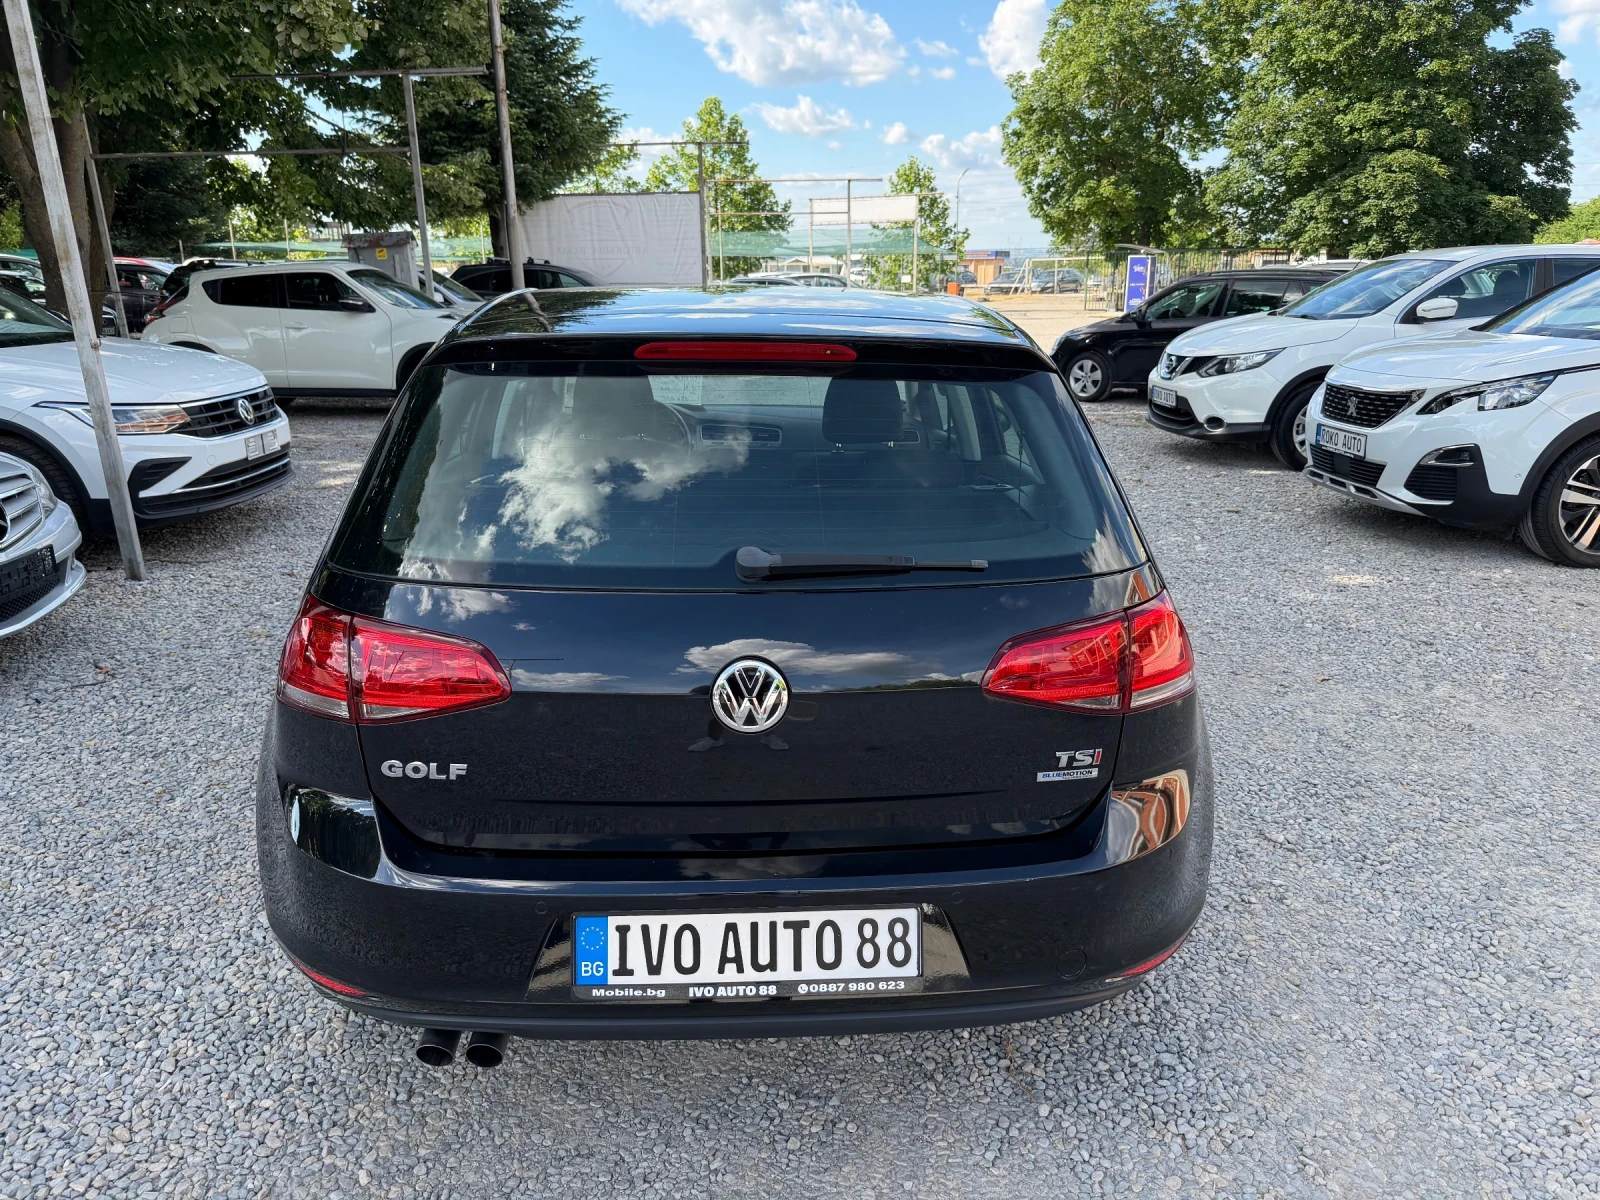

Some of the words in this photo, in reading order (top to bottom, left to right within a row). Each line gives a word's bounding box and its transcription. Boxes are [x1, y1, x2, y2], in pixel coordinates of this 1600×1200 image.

[1321, 428, 1339, 446] ROKO
[1341, 434, 1362, 452] AUTO
[713, 660, 788, 732] VW
[381, 760, 468, 780] GOLF
[1042, 770, 1093, 779] BLUEMOTION
[612, 923, 701, 976] IVO
[717, 918, 842, 975] AUTO
[856, 917, 912, 969] 88
[581, 962, 604, 976] BG
[592, 988, 666, 998] Mobile.bg
[689, 986, 714, 997] IVO
[717, 985, 757, 997] AUTO
[759, 985, 777, 995] 88
[809, 983, 845, 992] 0887
[848, 982, 875, 991] 980
[879, 981, 905, 990] 623
